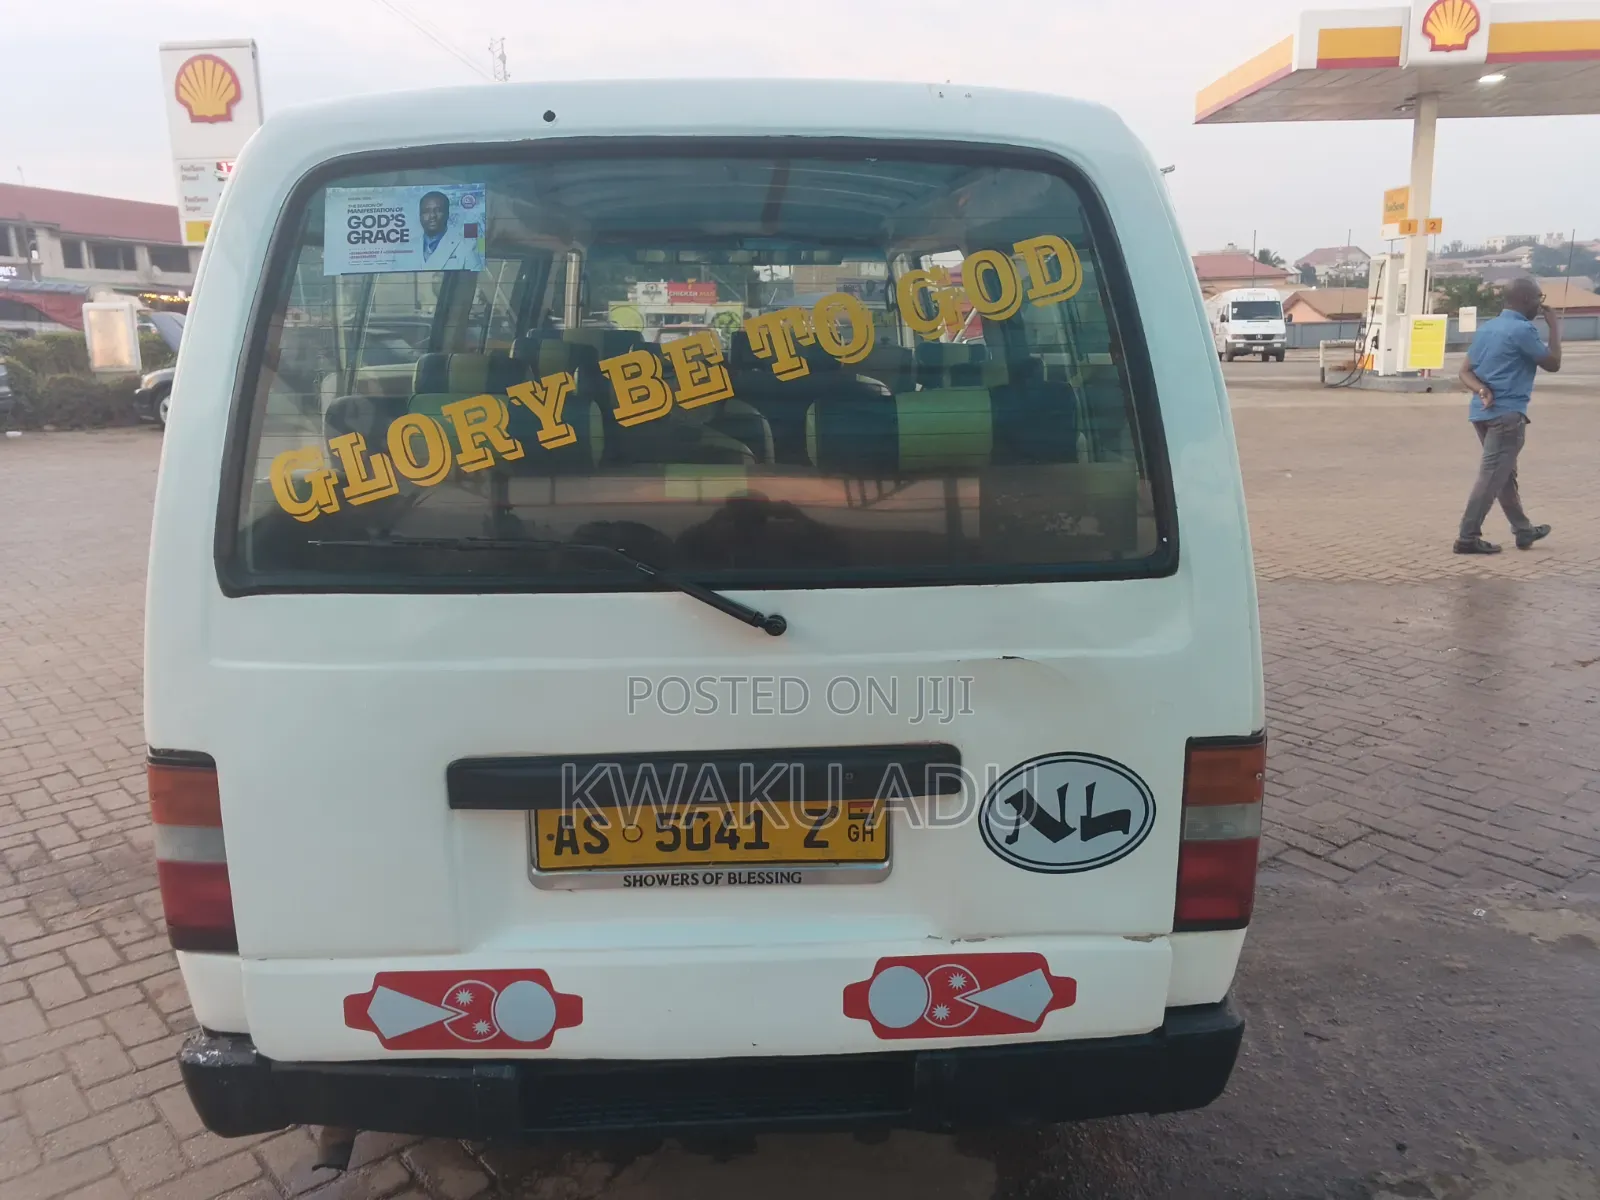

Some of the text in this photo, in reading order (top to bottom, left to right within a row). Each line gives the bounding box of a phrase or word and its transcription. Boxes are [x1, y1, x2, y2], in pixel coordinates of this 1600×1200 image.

[347, 207, 395, 215] MANIFESTATION
[347, 213, 407, 230] GOD'S
[1429, 221, 1437, 231] 2
[347, 228, 410, 245] GRACE
[270, 234, 1083, 523] GLORY BE TO GOD
[553, 808, 874, 856] AS 5041 Z GH
[623, 871, 803, 888] SHOWERS OF BLESSING
